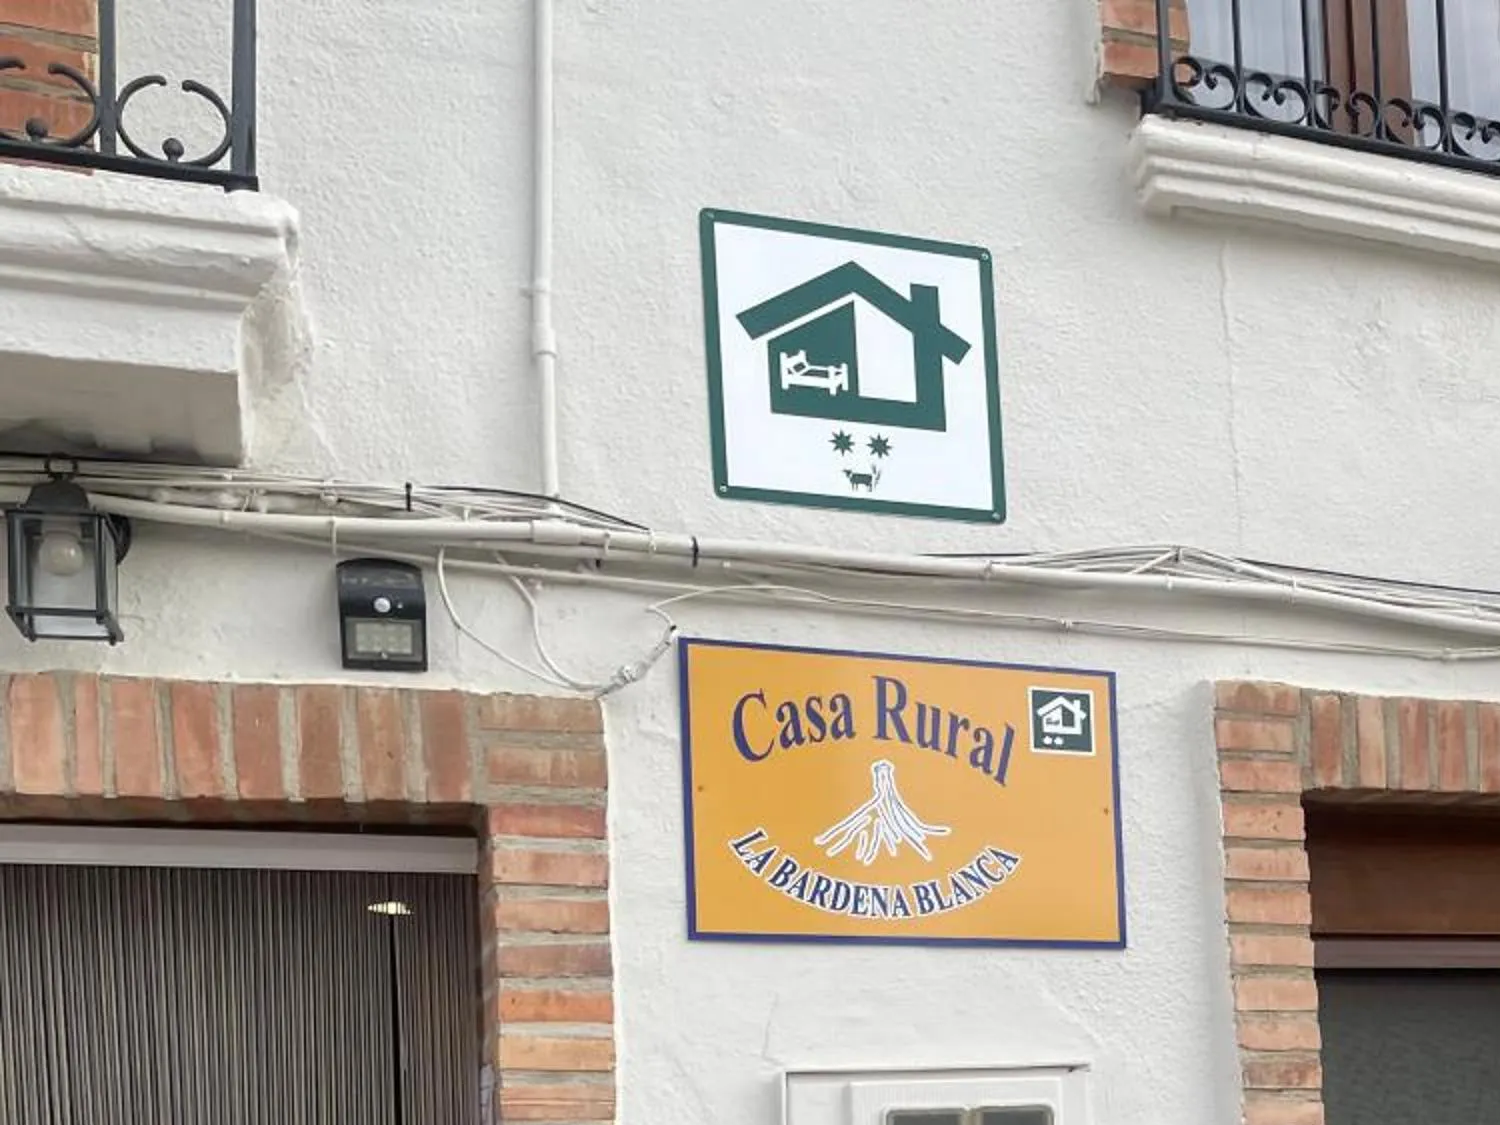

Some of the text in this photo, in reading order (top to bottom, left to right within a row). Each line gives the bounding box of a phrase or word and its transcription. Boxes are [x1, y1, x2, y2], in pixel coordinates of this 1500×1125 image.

[732, 675, 1016, 787] Casa Rural
[730, 829, 1020, 917] LA BARDENA BLANCA
